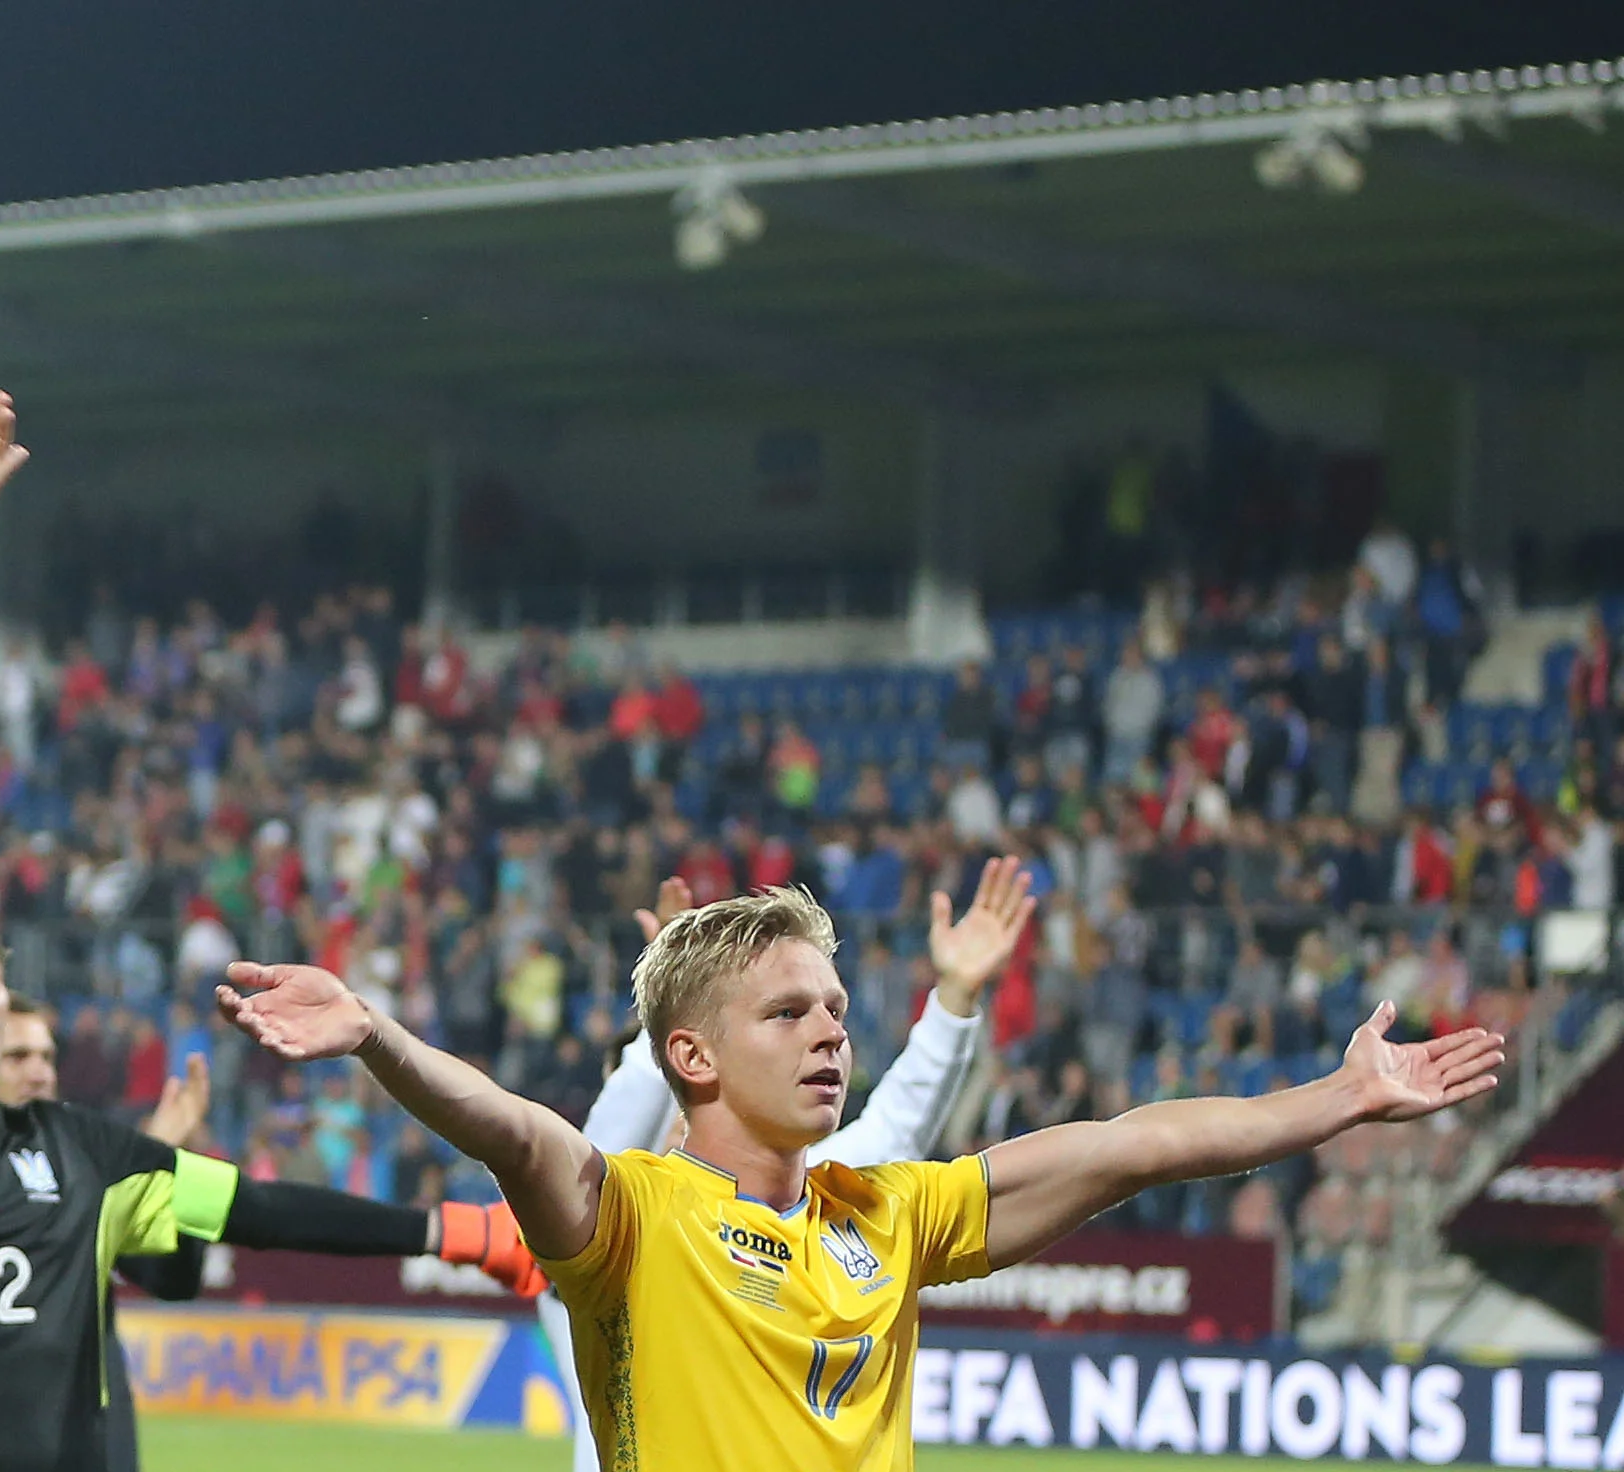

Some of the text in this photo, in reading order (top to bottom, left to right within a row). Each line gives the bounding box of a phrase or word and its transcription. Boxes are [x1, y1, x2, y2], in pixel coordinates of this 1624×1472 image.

[804, 1334, 873, 1420] 17
[912, 1348, 1055, 1447] EFA
[1070, 1354, 1467, 1465] NATIONS
